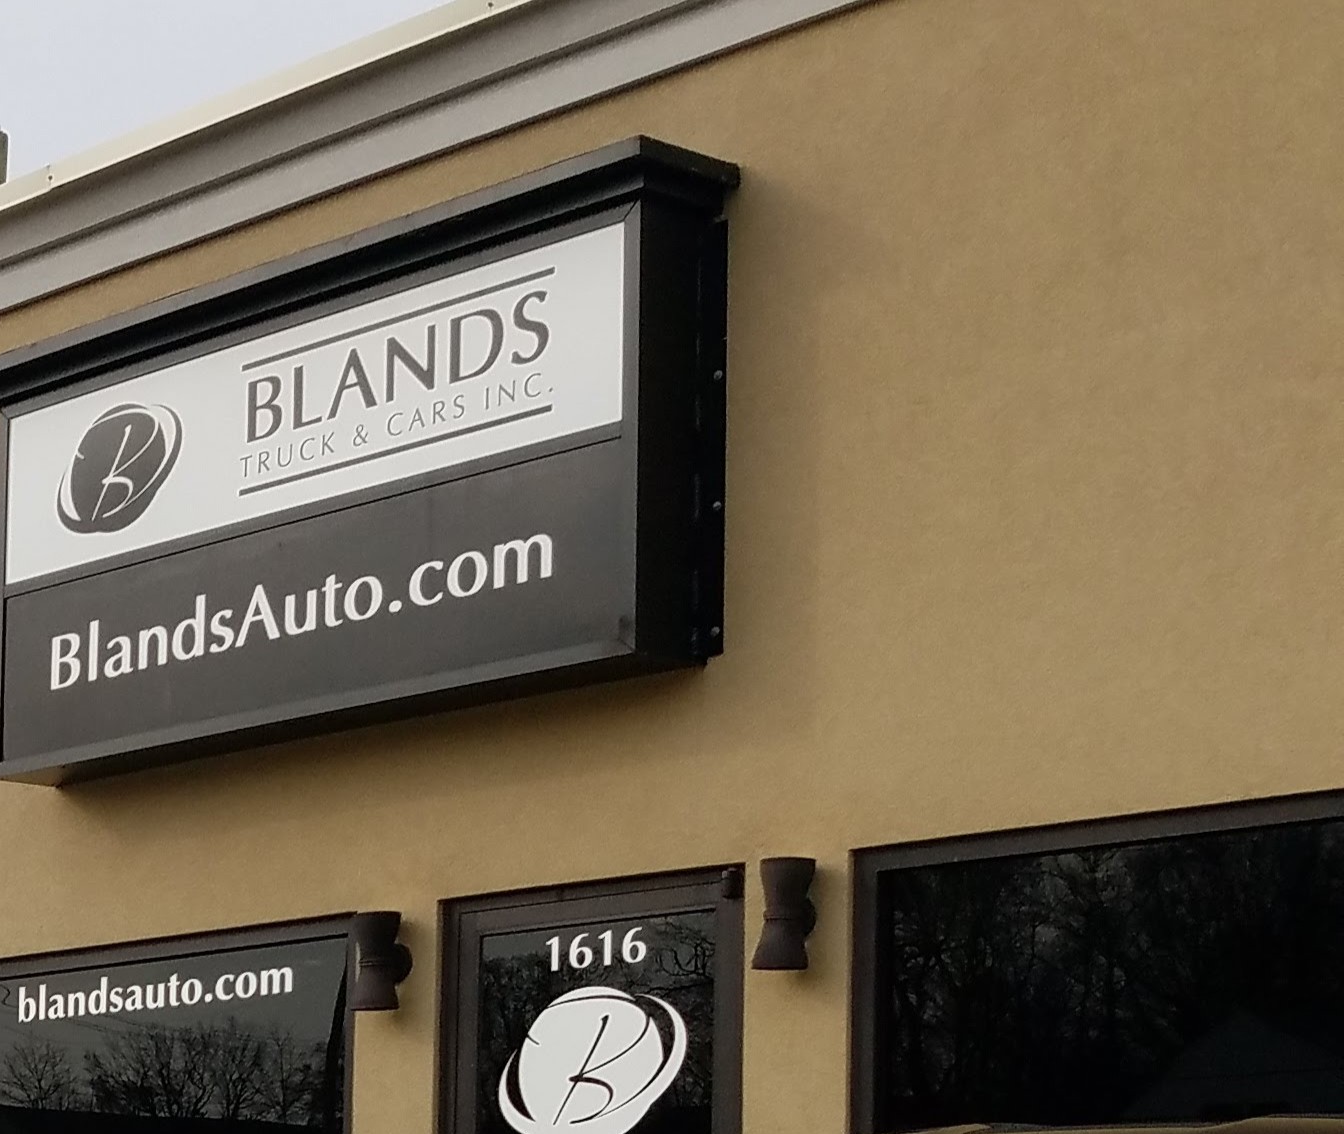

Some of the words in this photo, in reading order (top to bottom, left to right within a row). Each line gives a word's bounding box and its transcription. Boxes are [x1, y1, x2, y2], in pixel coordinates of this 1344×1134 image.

[246, 290, 550, 443] BLANDS
[240, 431, 335, 477] TRUCK
[352, 424, 369, 447] &
[386, 394, 466, 437] CARS
[484, 372, 554, 410] INC.
[49, 532, 553, 690] BlandsAuto.com
[17, 966, 294, 1023] blandsauto.com
[545, 926, 647, 972] 1616
